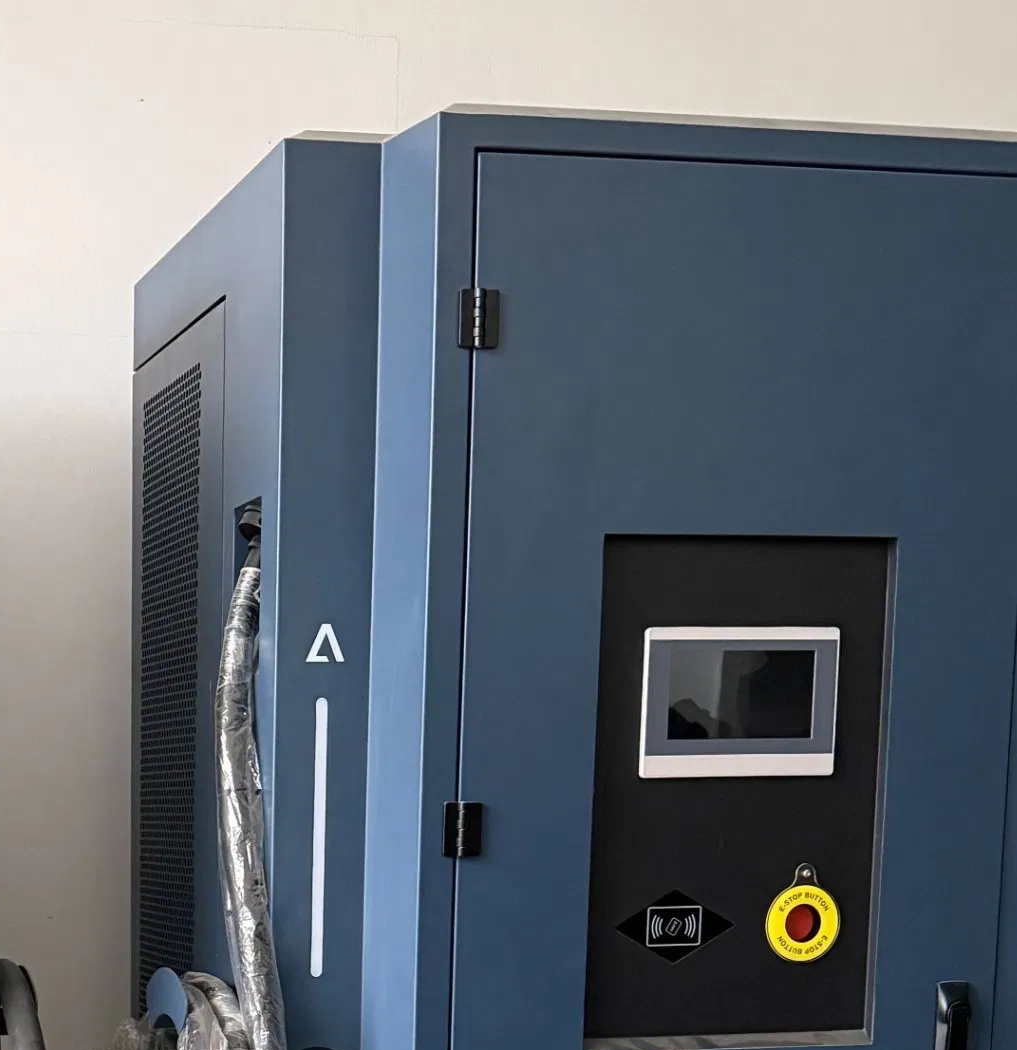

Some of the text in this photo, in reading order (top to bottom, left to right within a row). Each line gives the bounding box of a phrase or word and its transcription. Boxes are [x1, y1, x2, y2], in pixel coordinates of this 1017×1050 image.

[305, 623, 345, 663] A
[778, 892, 830, 912] E-STOP BUTTON
[777, 935, 828, 955] E-STOP BUTTON
